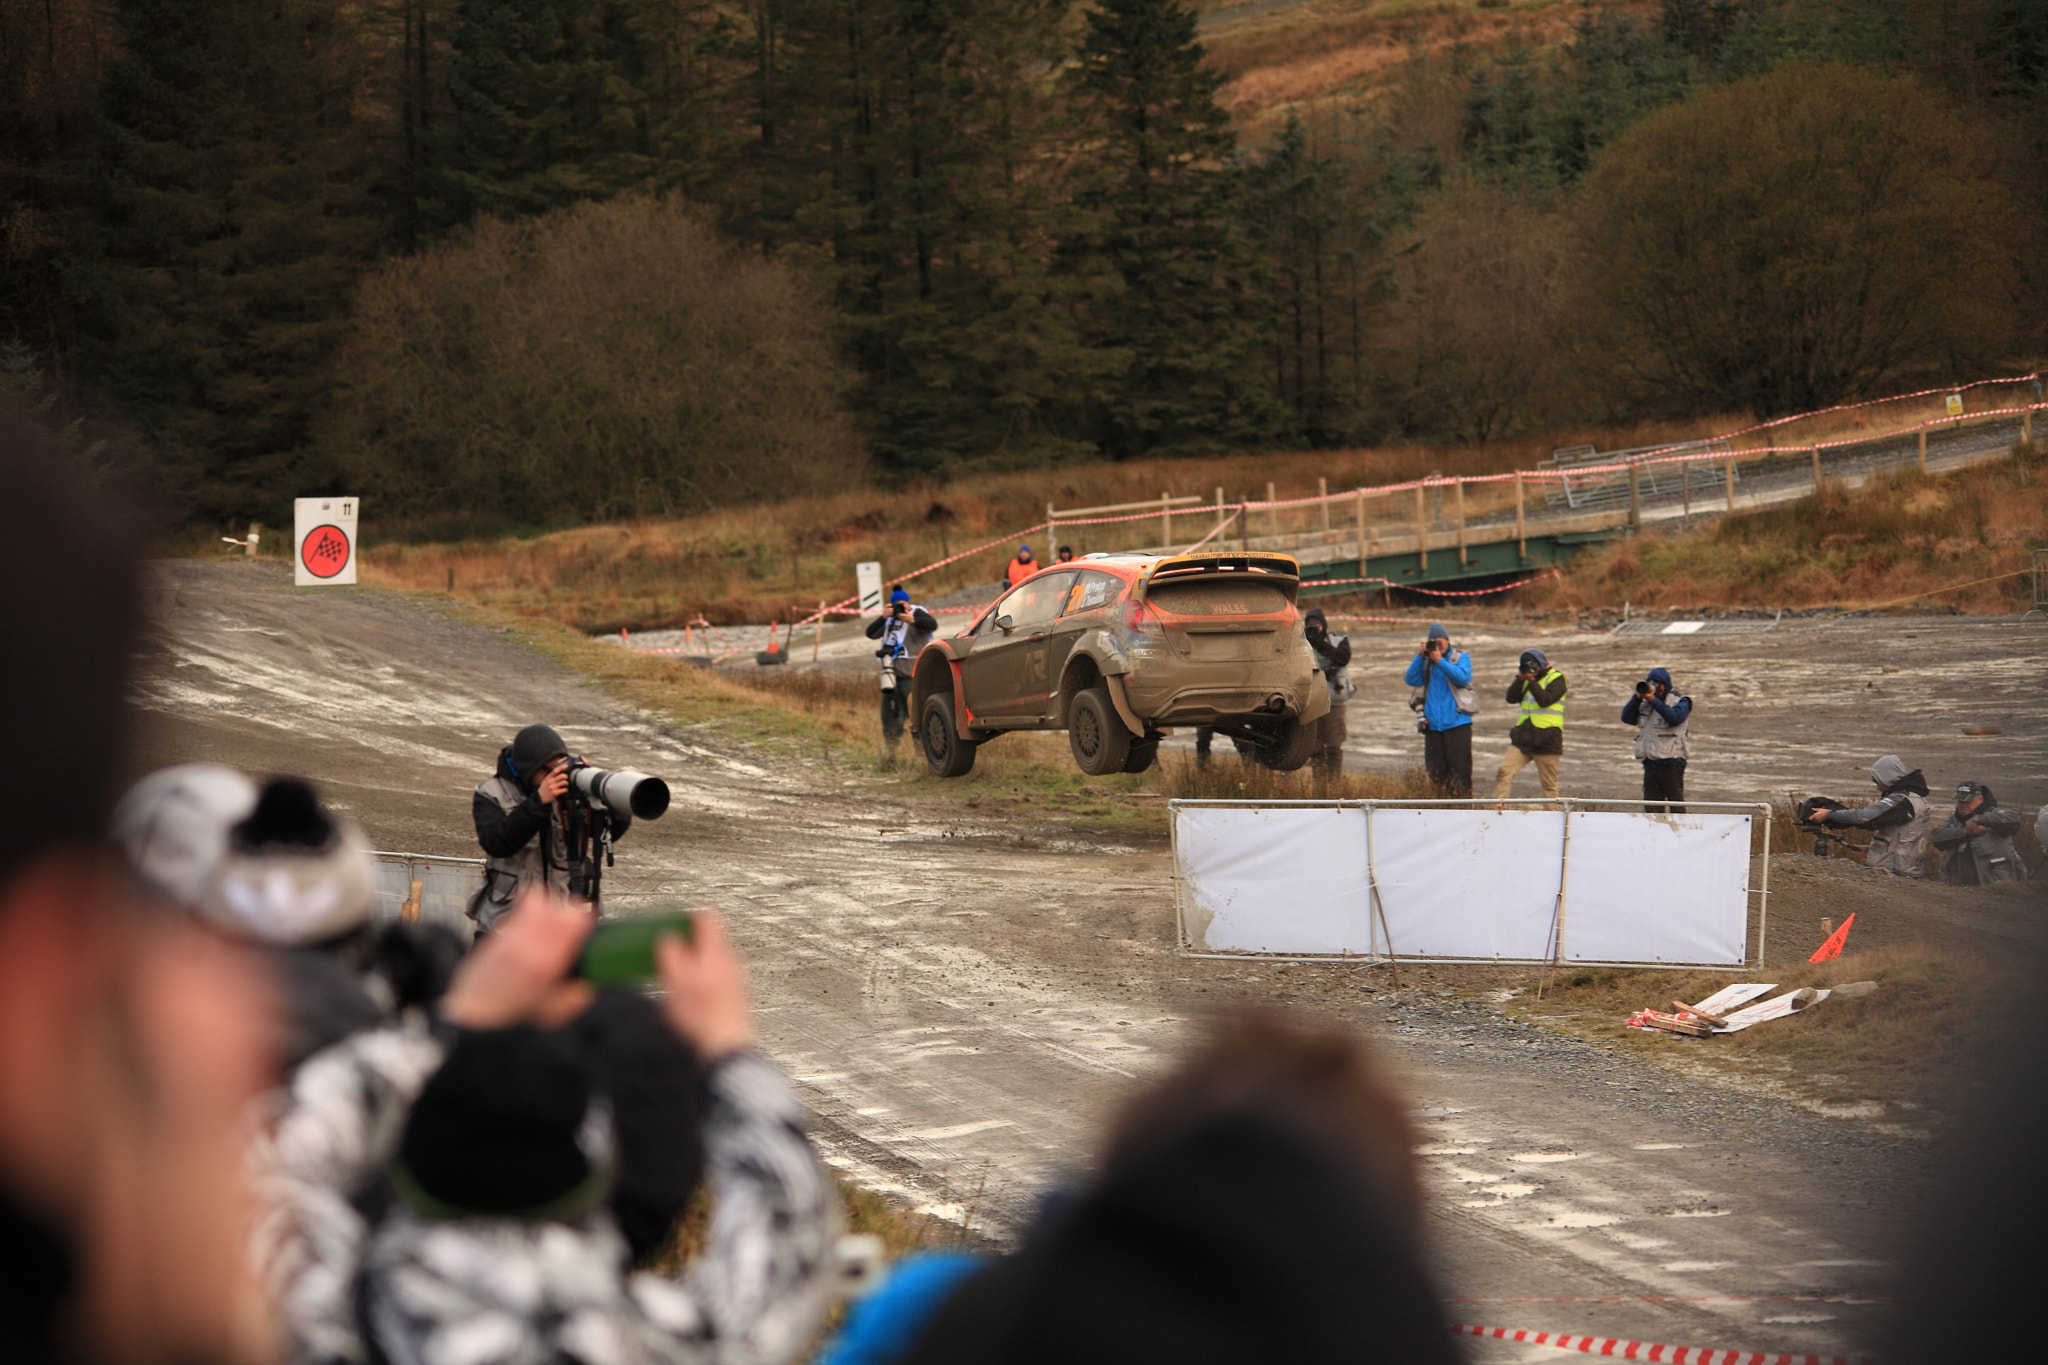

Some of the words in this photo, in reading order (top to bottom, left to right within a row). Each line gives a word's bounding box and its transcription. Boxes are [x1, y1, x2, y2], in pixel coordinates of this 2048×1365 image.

[343, 503, 351, 515] 11
[1066, 584, 1086, 612] 21
[1210, 603, 1248, 614] WALES
